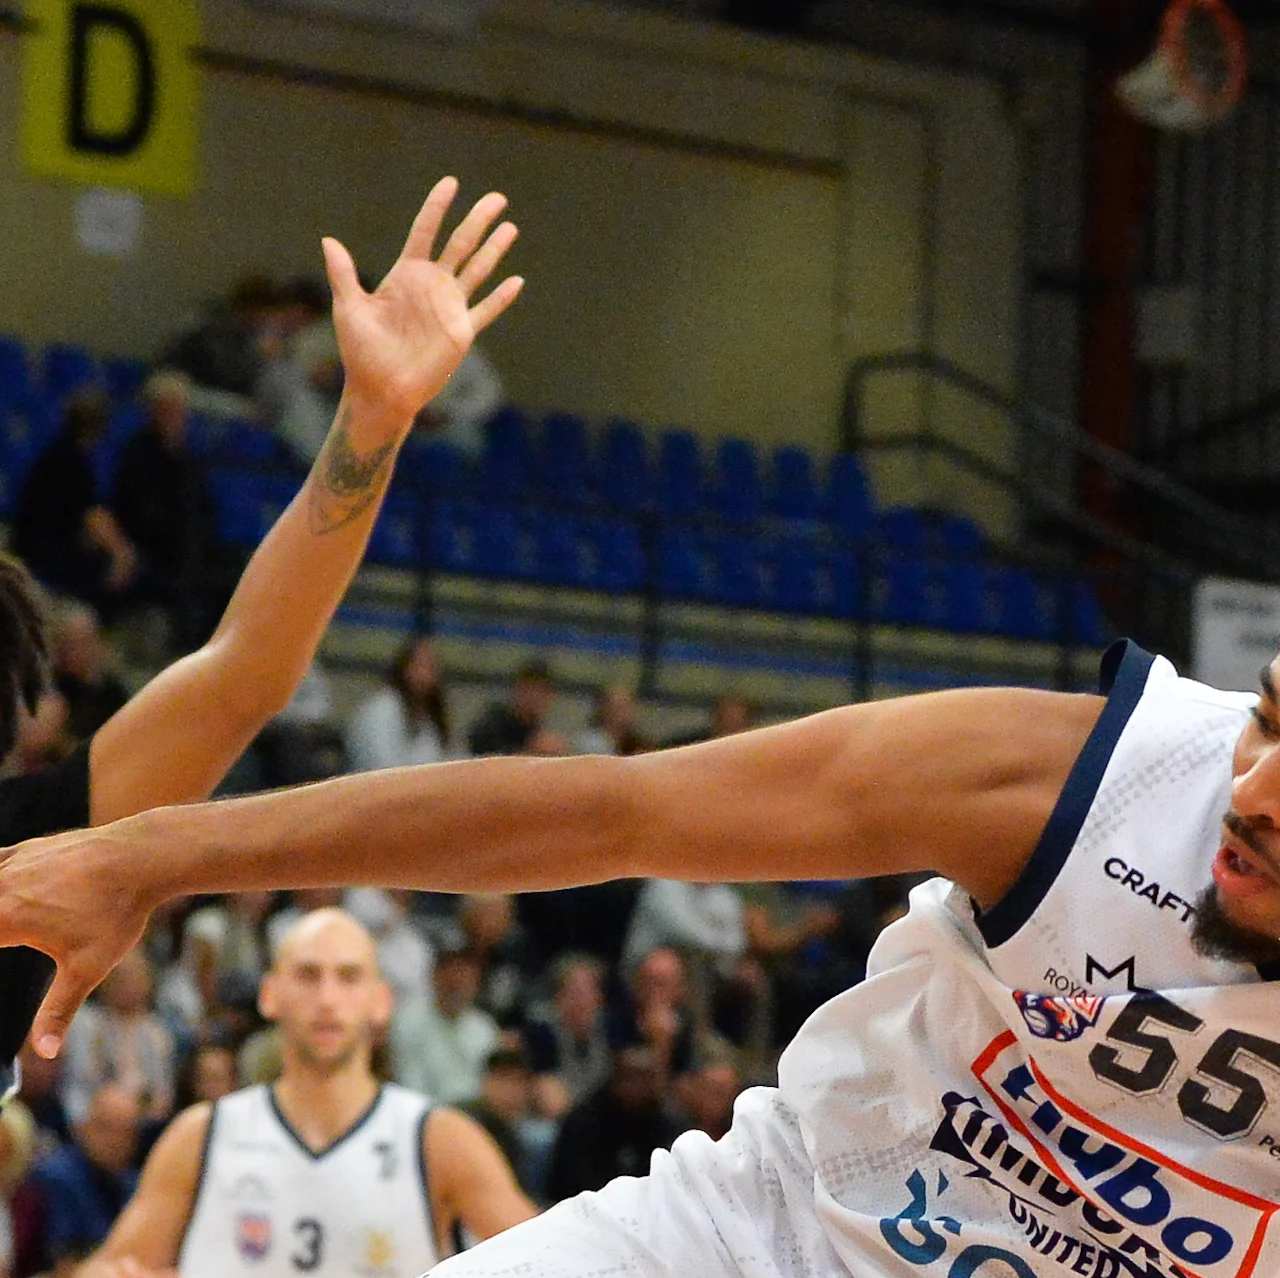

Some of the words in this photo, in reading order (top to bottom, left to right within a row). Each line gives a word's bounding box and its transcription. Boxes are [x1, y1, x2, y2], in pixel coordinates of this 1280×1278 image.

[66, 6, 156, 156] D
[1104, 857, 1196, 922] CRAFT
[1043, 967, 1088, 1005] ROYA
[289, 1217, 324, 1272] 3
